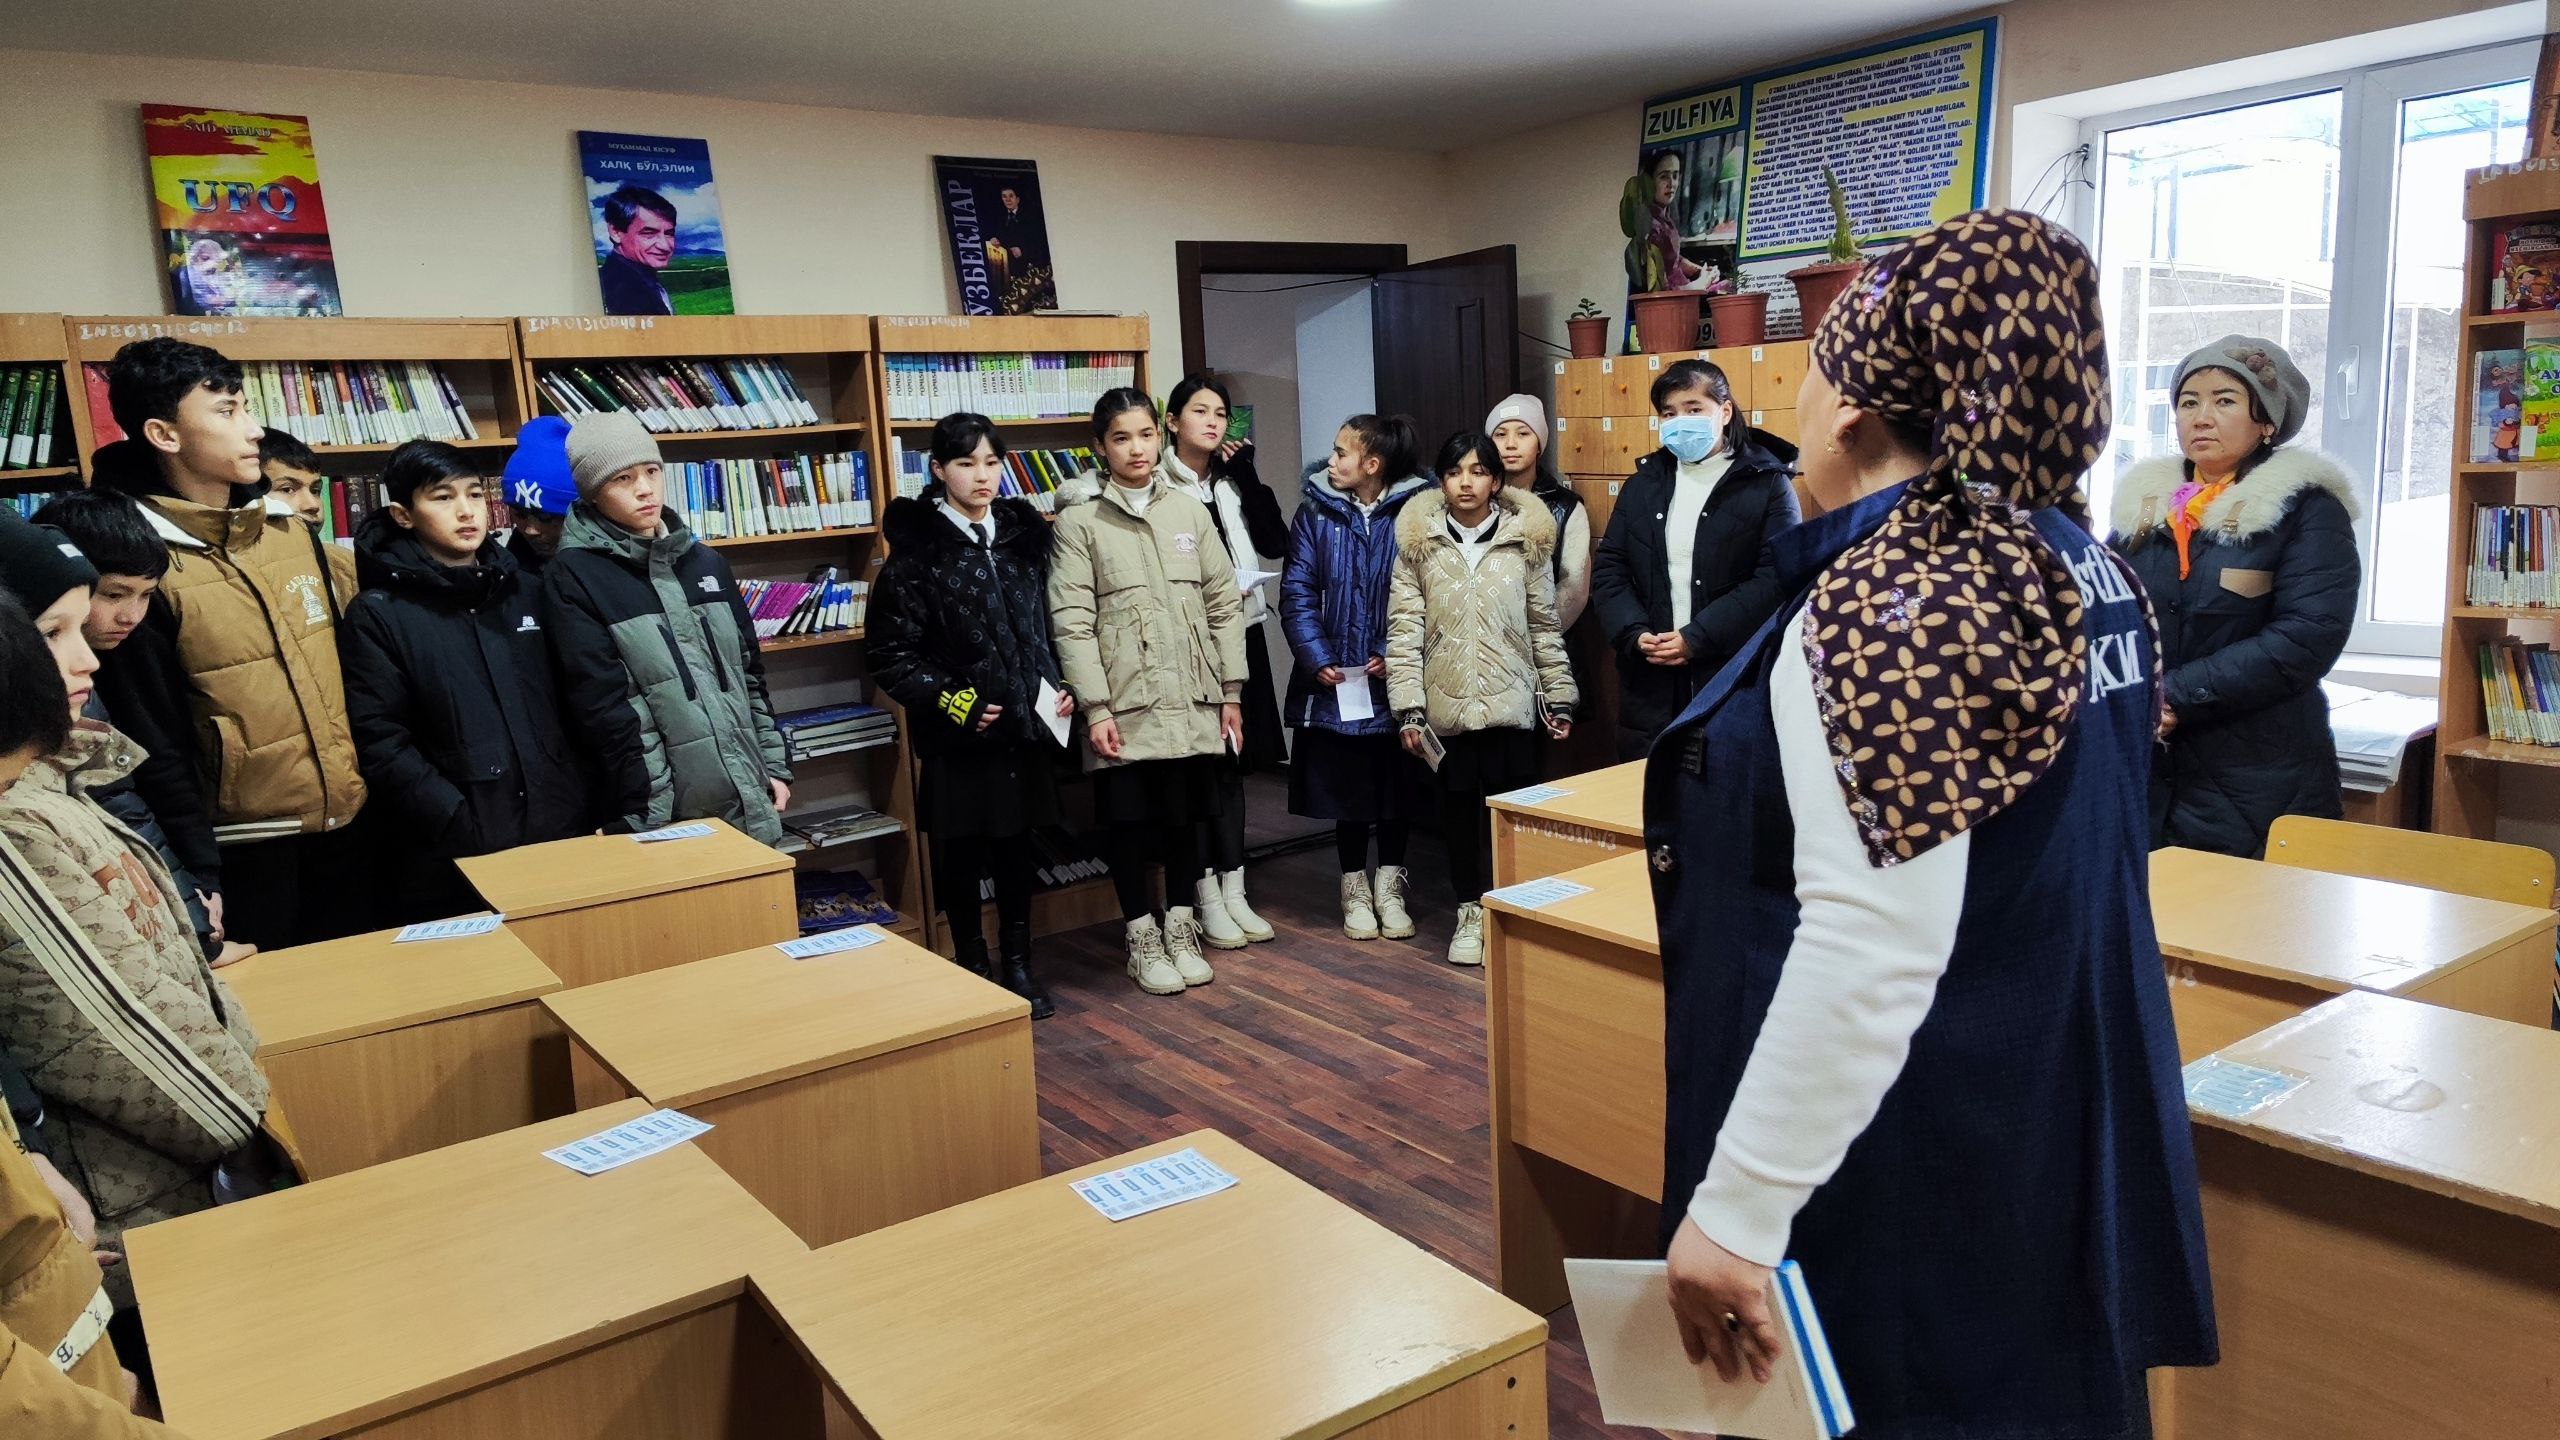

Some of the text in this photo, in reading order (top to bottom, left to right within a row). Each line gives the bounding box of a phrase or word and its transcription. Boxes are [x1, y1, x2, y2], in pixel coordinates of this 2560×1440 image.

[1647, 95, 1735, 136] ZULFIYA
[600, 160, 632, 171] ХАЛҚ
[178, 178, 297, 222] UFQ
[514, 478, 543, 509] NY
